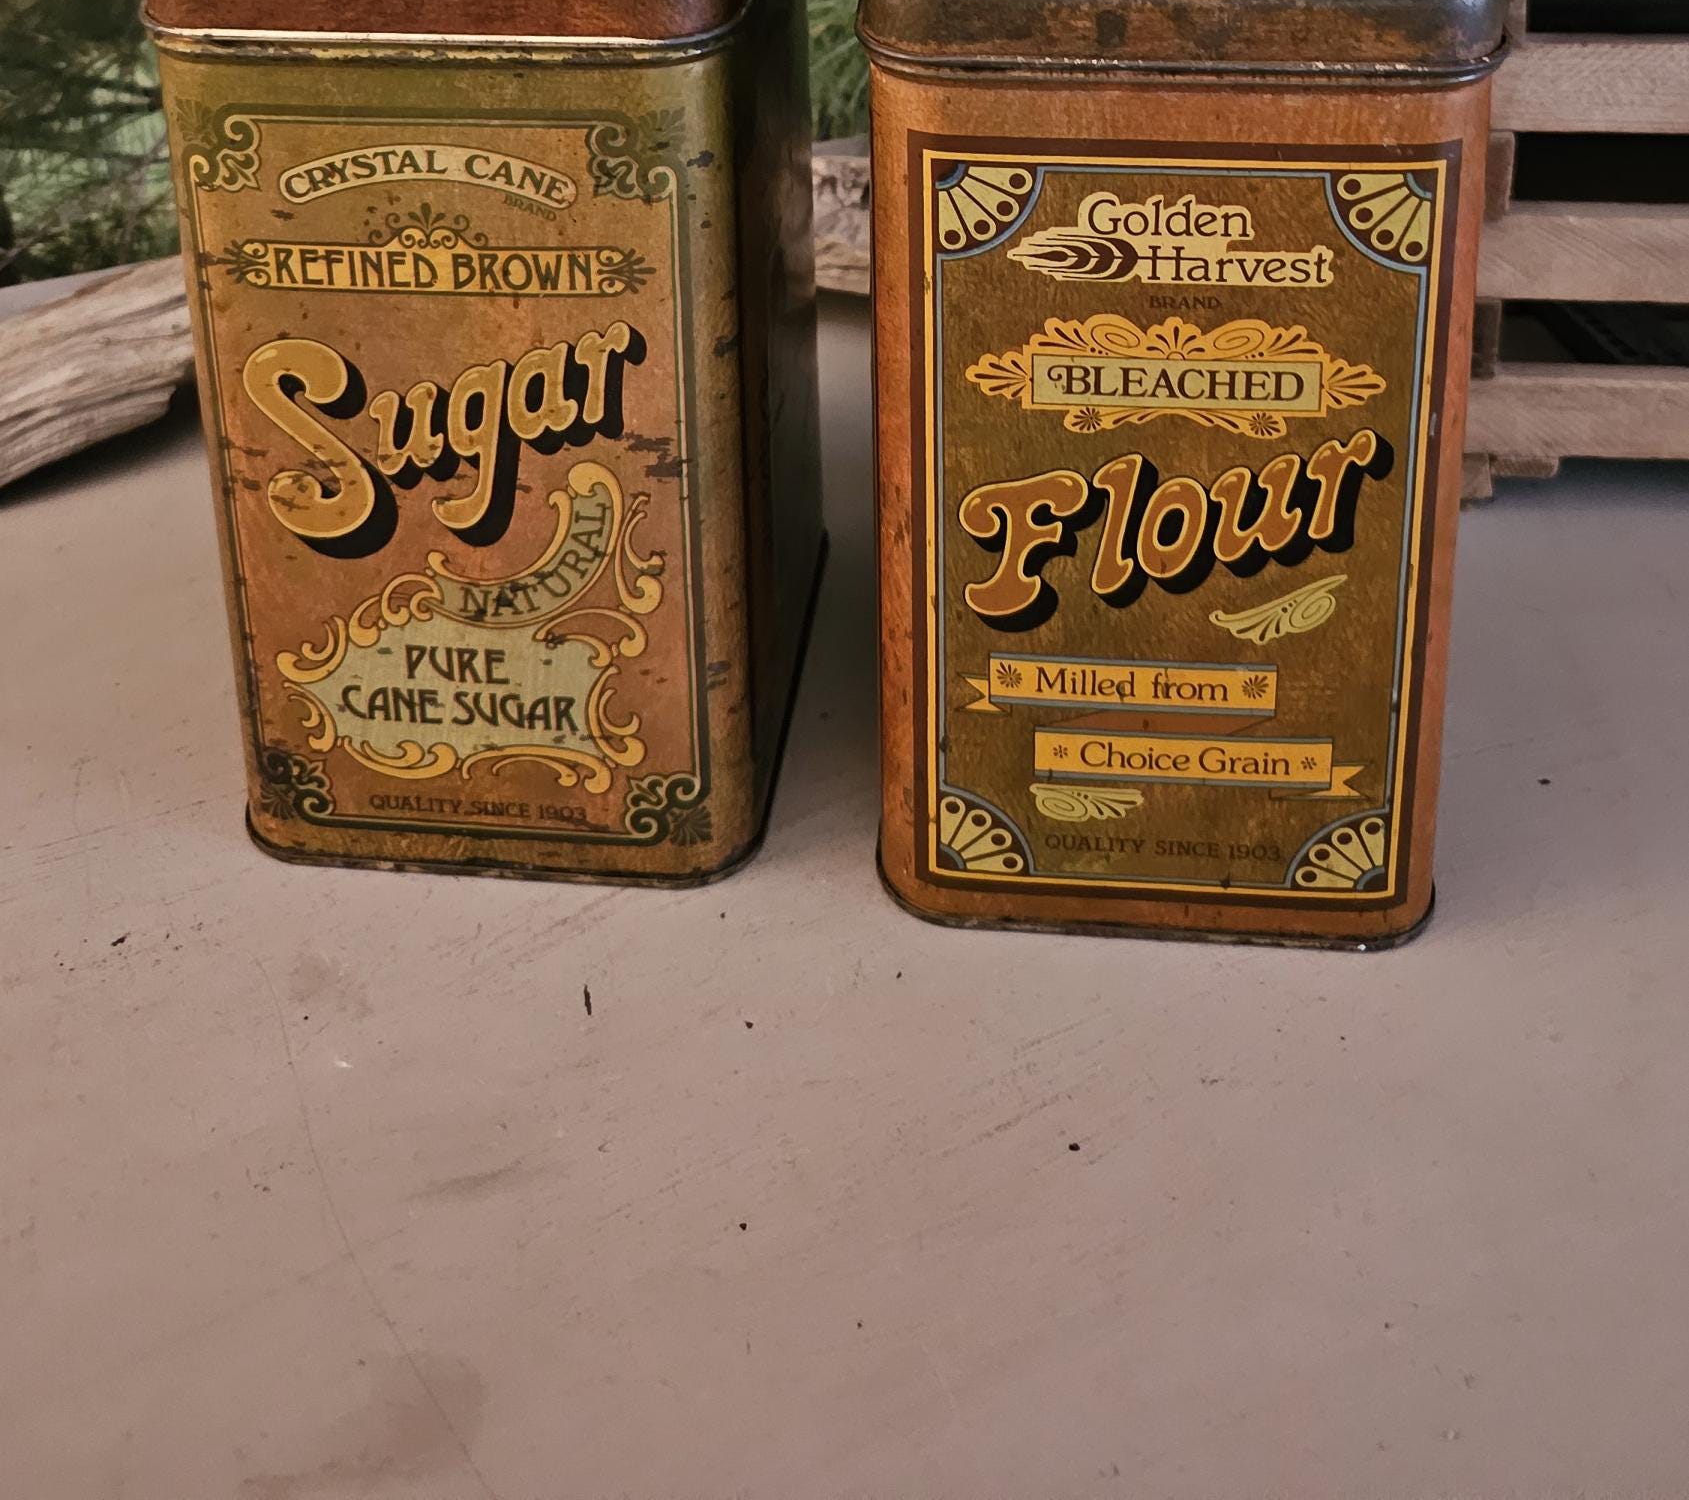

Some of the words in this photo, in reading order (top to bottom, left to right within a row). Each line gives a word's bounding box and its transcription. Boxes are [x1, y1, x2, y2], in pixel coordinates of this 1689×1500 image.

[285, 149, 448, 199] CRYSTAL
[464, 154, 570, 207] CANE
[502, 194, 558, 221] BRAND
[1087, 198, 1250, 238] Golden
[273, 246, 438, 288] REFINED
[451, 251, 594, 291] BROWN
[1148, 244, 1328, 284] Harvest
[1149, 295, 1219, 311] BRAND
[1046, 363, 1305, 402] BLEACHED
[243, 320, 644, 556] Sugar
[958, 428, 1390, 628] Flour
[460, 500, 612, 619] NATURAL
[405, 644, 510, 685] PURE
[1034, 666, 1137, 699] Milled
[1150, 669, 1229, 702] from
[341, 685, 443, 726] CANE
[452, 690, 580, 734] SUGAR
[1080, 740, 1191, 771] Choice
[1198, 747, 1290, 775] Grain
[368, 794, 462, 814] QUALITY
[471, 801, 531, 819] SINCE
[537, 804, 588, 822] 1903
[1044, 834, 1145, 855] QUALITY
[1155, 840, 1220, 859] SINCE
[1227, 843, 1282, 861] 1903
